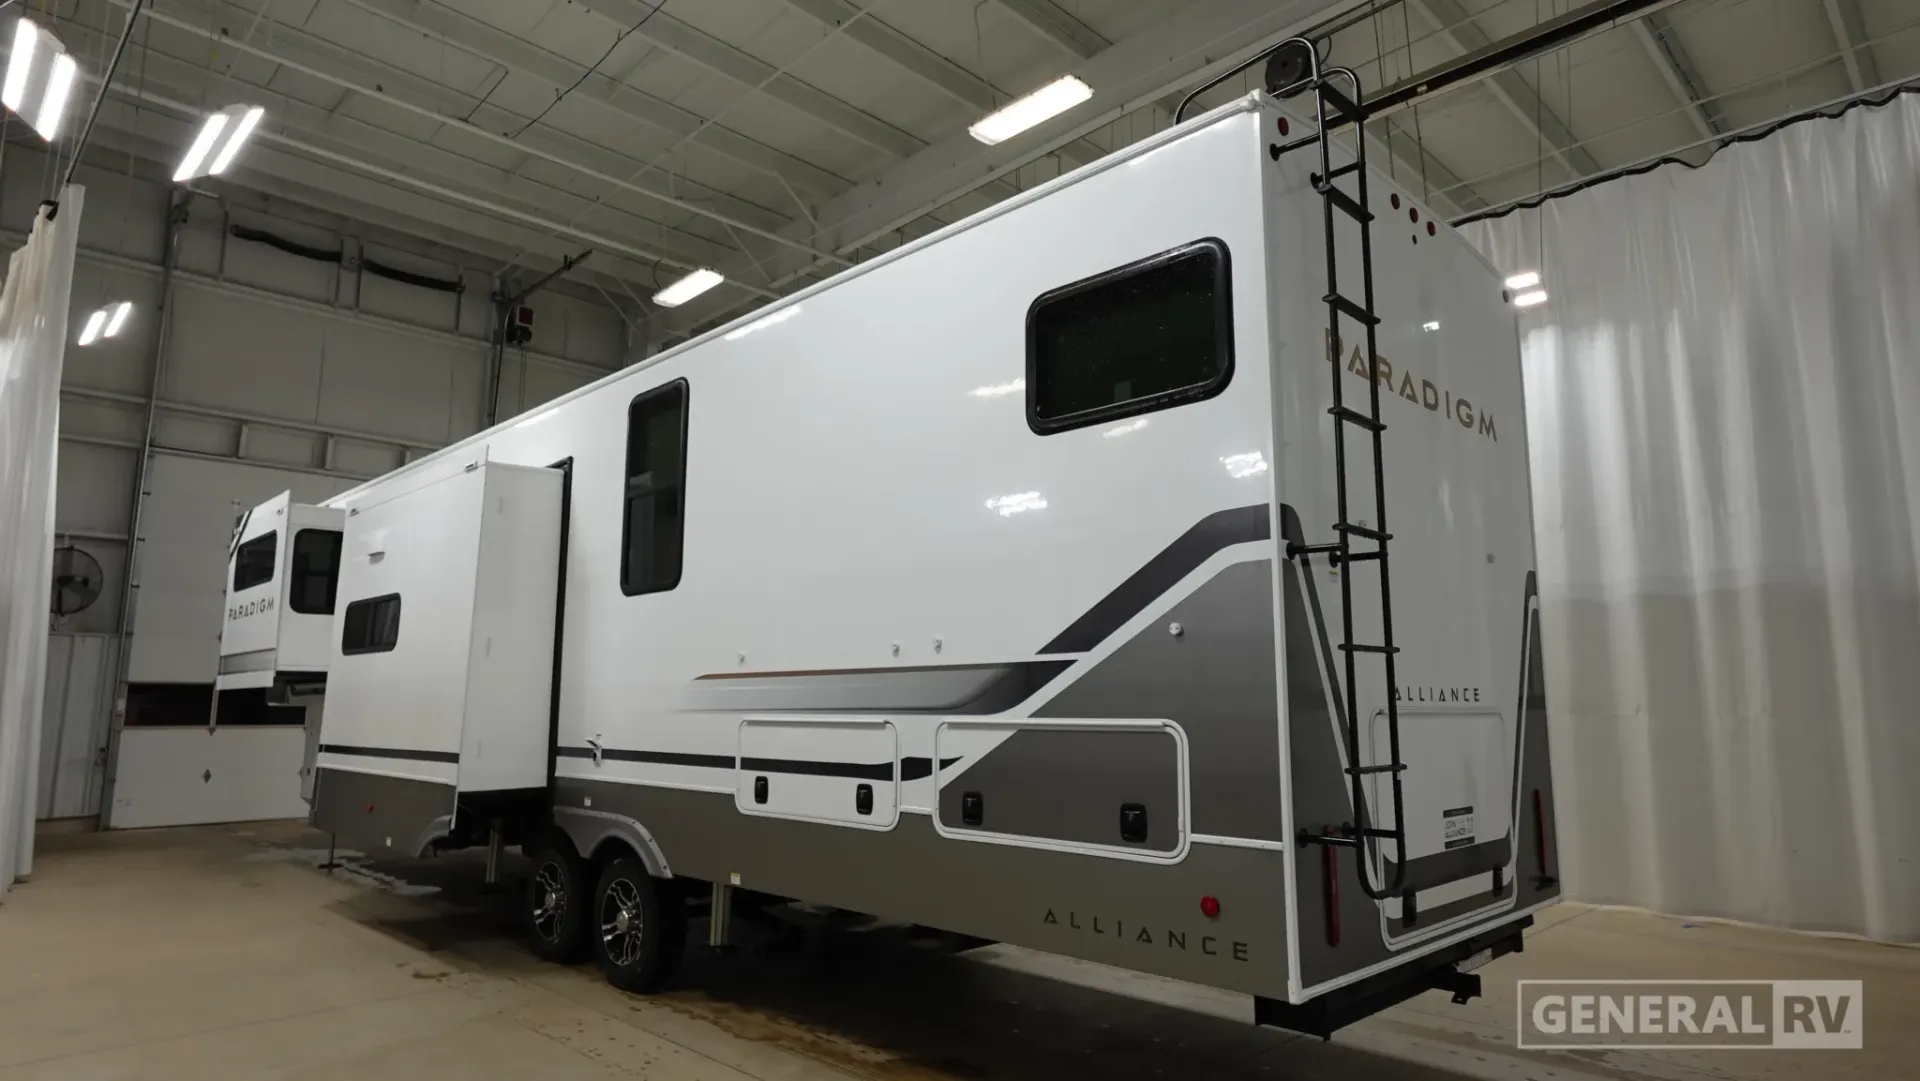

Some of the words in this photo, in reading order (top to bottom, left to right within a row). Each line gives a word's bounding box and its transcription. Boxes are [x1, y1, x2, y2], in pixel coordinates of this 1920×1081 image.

[1325, 326, 1497, 442] PARADIGM
[228, 596, 274, 620] PARADIGM
[1395, 686, 1480, 702] ALLIANCE
[1043, 908, 1249, 962] ALLIANCE
